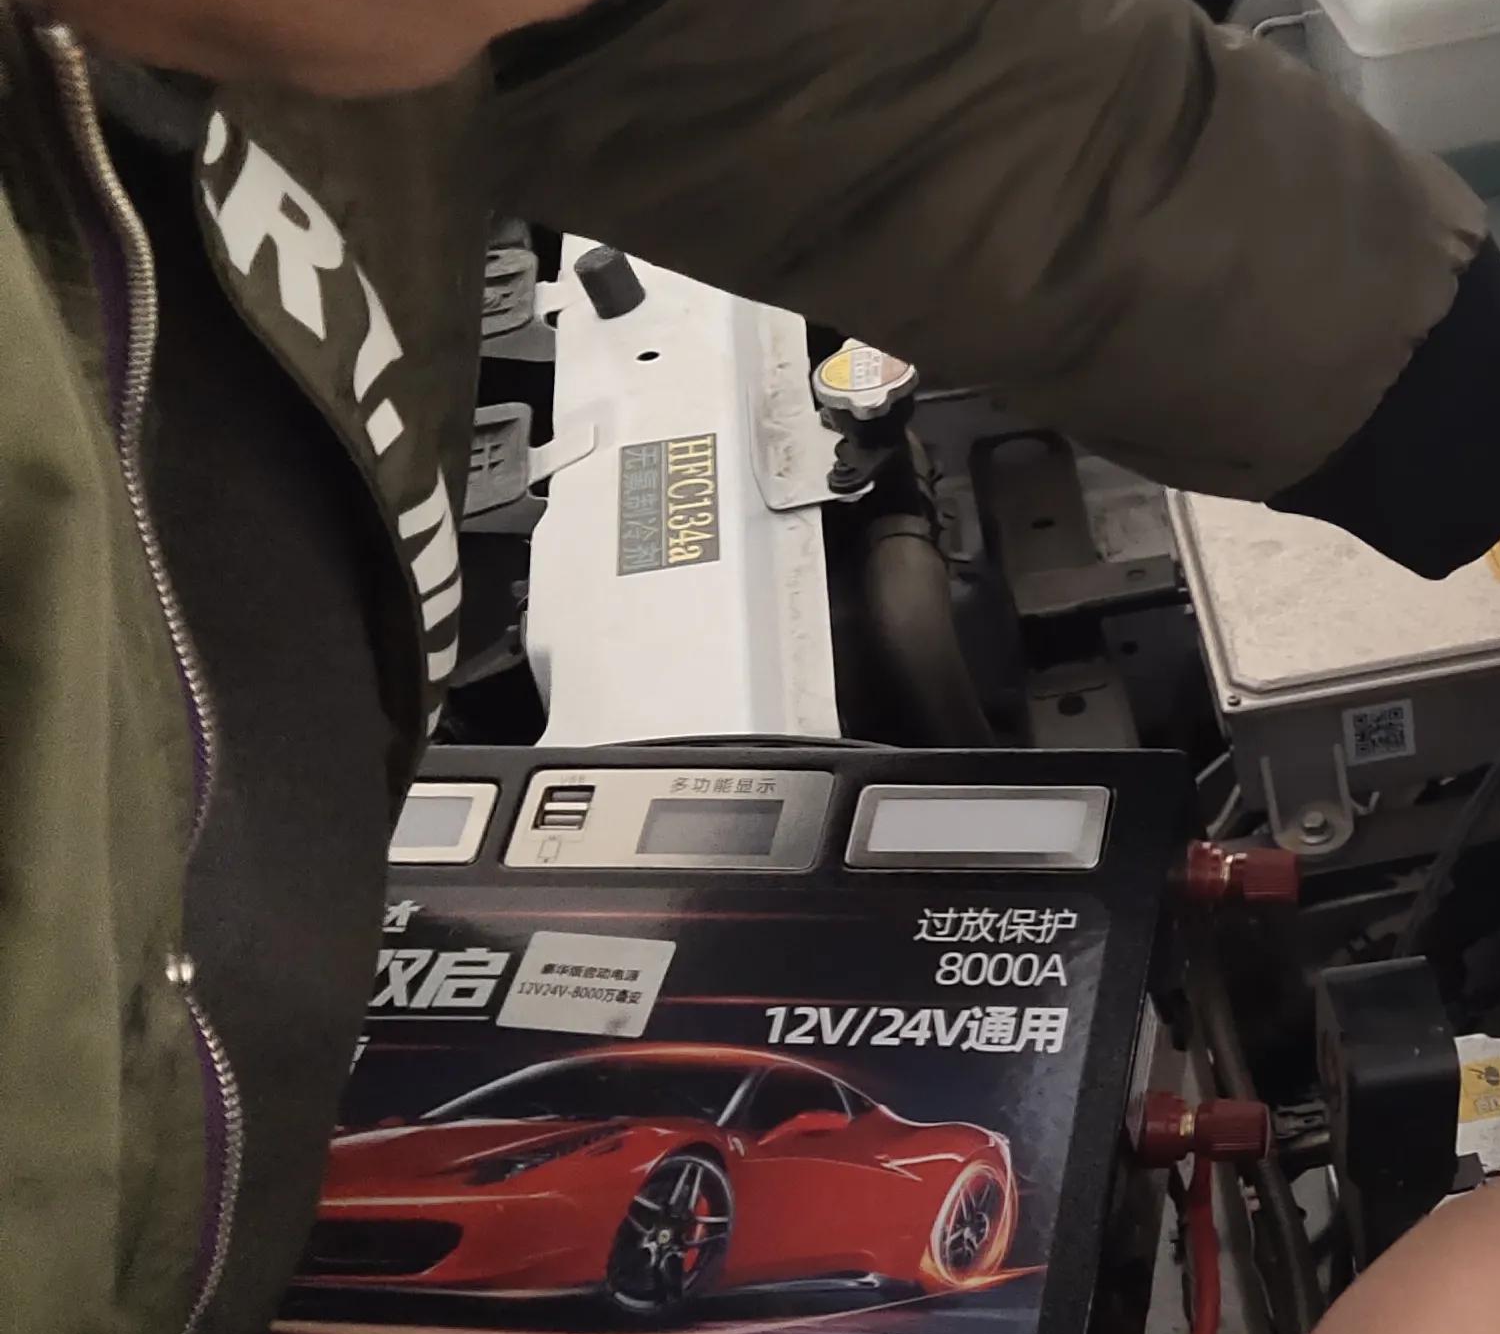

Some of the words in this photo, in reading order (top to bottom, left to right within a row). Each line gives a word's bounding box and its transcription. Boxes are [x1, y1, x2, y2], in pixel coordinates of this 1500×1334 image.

[667, 436, 715, 564] HFC134a
[670, 777, 777, 794] 多功能显示
[913, 908, 1077, 943] 过放保护
[935, 953, 1067, 986] 8000A
[765, 1006, 1069, 1053] 12V/24V通用
